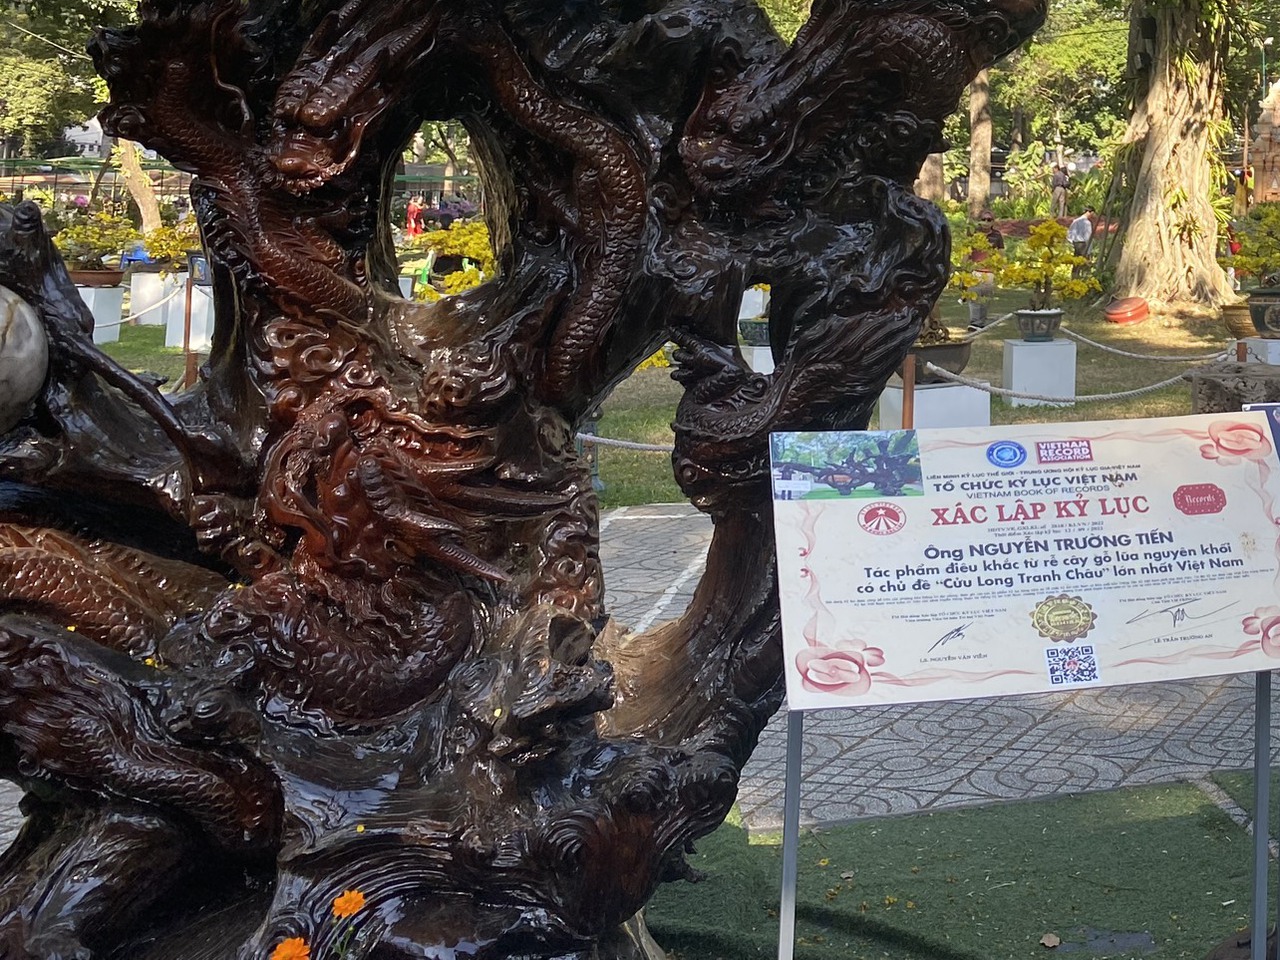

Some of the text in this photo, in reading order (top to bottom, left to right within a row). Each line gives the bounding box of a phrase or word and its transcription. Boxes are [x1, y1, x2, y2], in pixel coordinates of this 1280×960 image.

[1038, 440, 1088, 449] VIETNAM
[1039, 446, 1090, 457] RECORD
[1041, 453, 1091, 462] ASSOCIATION
[933, 479, 955, 492] TỔ
[961, 478, 1003, 490] CHỨC
[1033, 476, 1061, 488] LỤC
[1065, 473, 1096, 485] VIỆT
[1102, 472, 1137, 482] NAM
[967, 490, 1011, 499] VIETNAM
[1014, 488, 1043, 496] BOOK
[1062, 484, 1110, 494] RECORDS
[931, 502, 988, 526] XÁC
[996, 499, 1046, 525] LẬP
[1054, 493, 1089, 518] KỶ
[1098, 496, 1149, 518] LỤC
[924, 528, 1173, 561] Ông NGUYỄN TRƯỜNG TIẾN
[864, 567, 890, 578] Tác
[896, 564, 939, 579] phẩm
[983, 558, 1019, 571] khắc
[1024, 557, 1038, 568] từ
[1044, 554, 1058, 567] rễ
[1063, 555, 1088, 567] cây
[1094, 551, 1111, 566] gỗ
[1116, 550, 1139, 561] lũa
[1144, 547, 1196, 561] nguyên
[1200, 542, 1231, 555] khối
[857, 582, 874, 593] có
[880, 580, 906, 592] chủ
[912, 578, 930, 590] đề
[977, 575, 1013, 587] Long
[1018, 569, 1061, 583] Tranh
[1113, 564, 1136, 576] lớn
[1141, 561, 1172, 574] nhất
[1176, 559, 1205, 572] Việt
[1209, 557, 1243, 568] Nam
